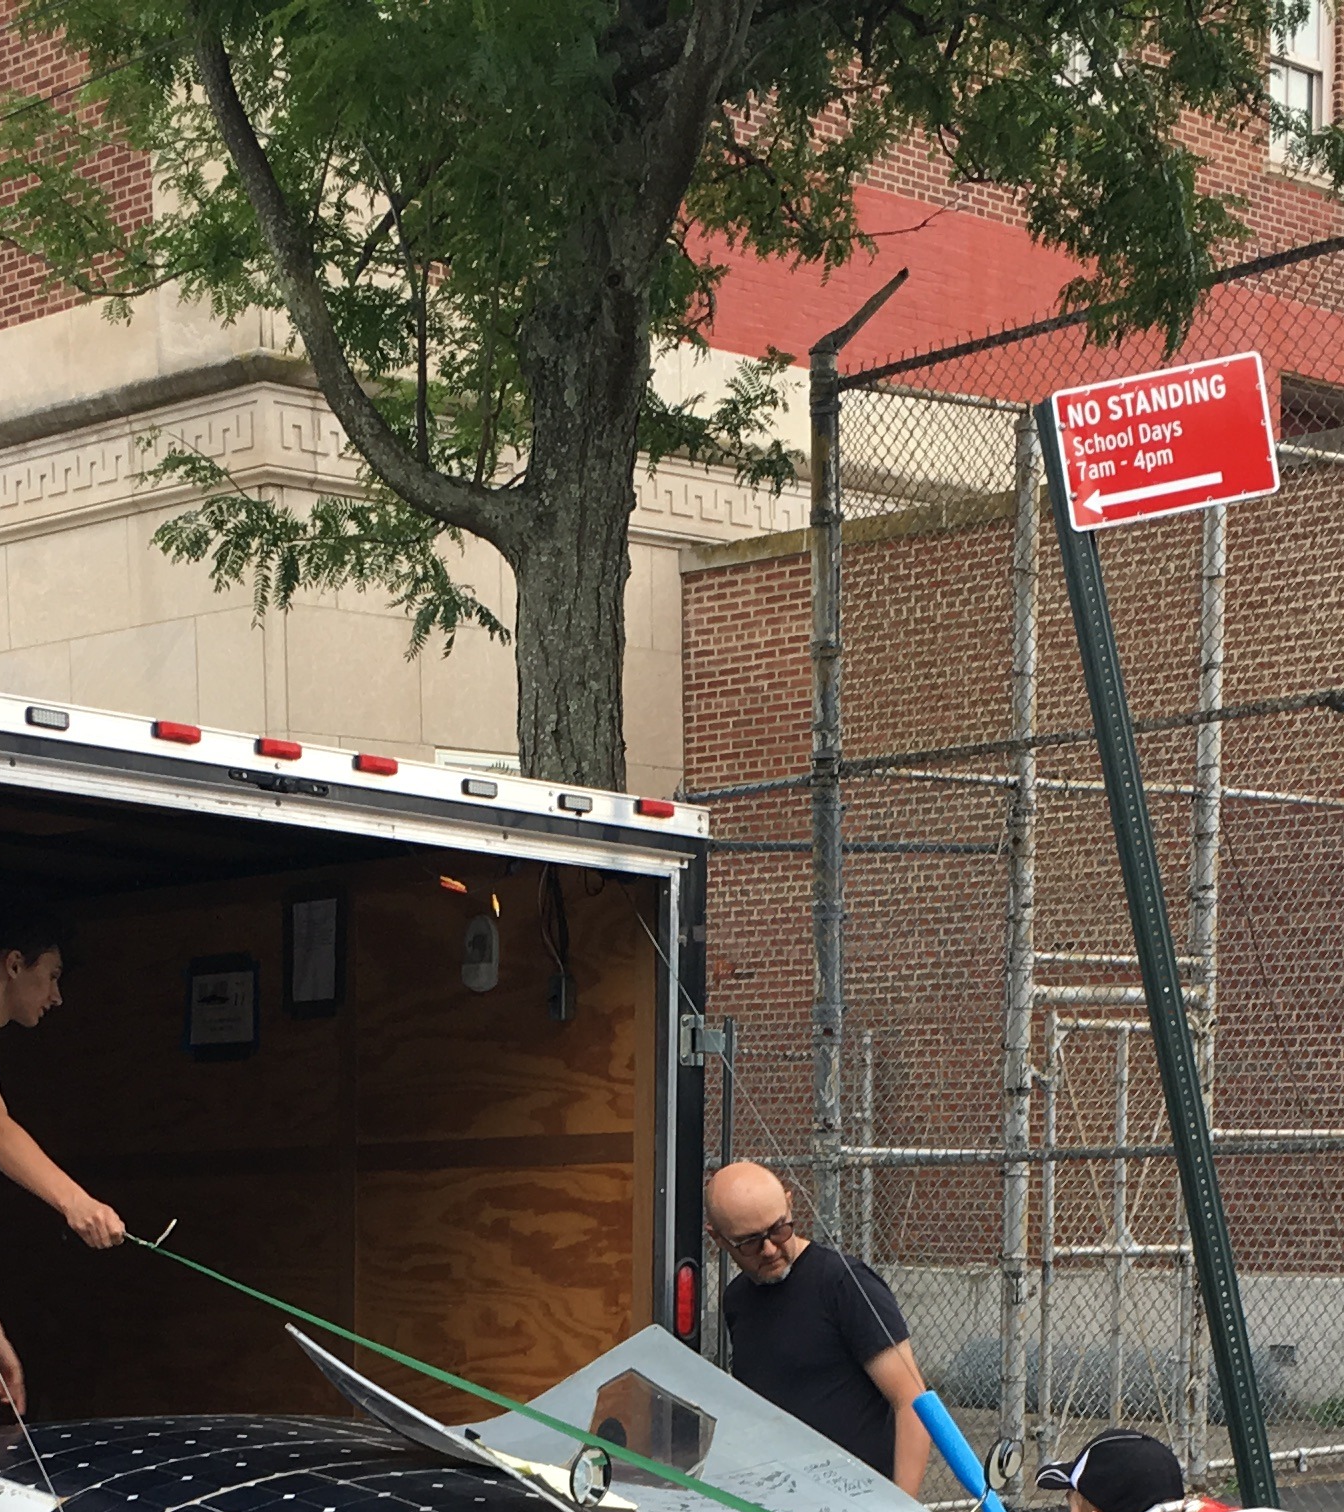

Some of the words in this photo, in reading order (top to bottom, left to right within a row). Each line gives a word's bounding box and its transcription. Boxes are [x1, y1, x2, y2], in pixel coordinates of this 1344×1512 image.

[1066, 402, 1101, 429] NO
[1108, 374, 1227, 421] STANDING
[1072, 426, 1135, 457] School
[1138, 418, 1184, 449] Days
[1075, 458, 1117, 482] 7am
[1134, 447, 1174, 474] 4pm
